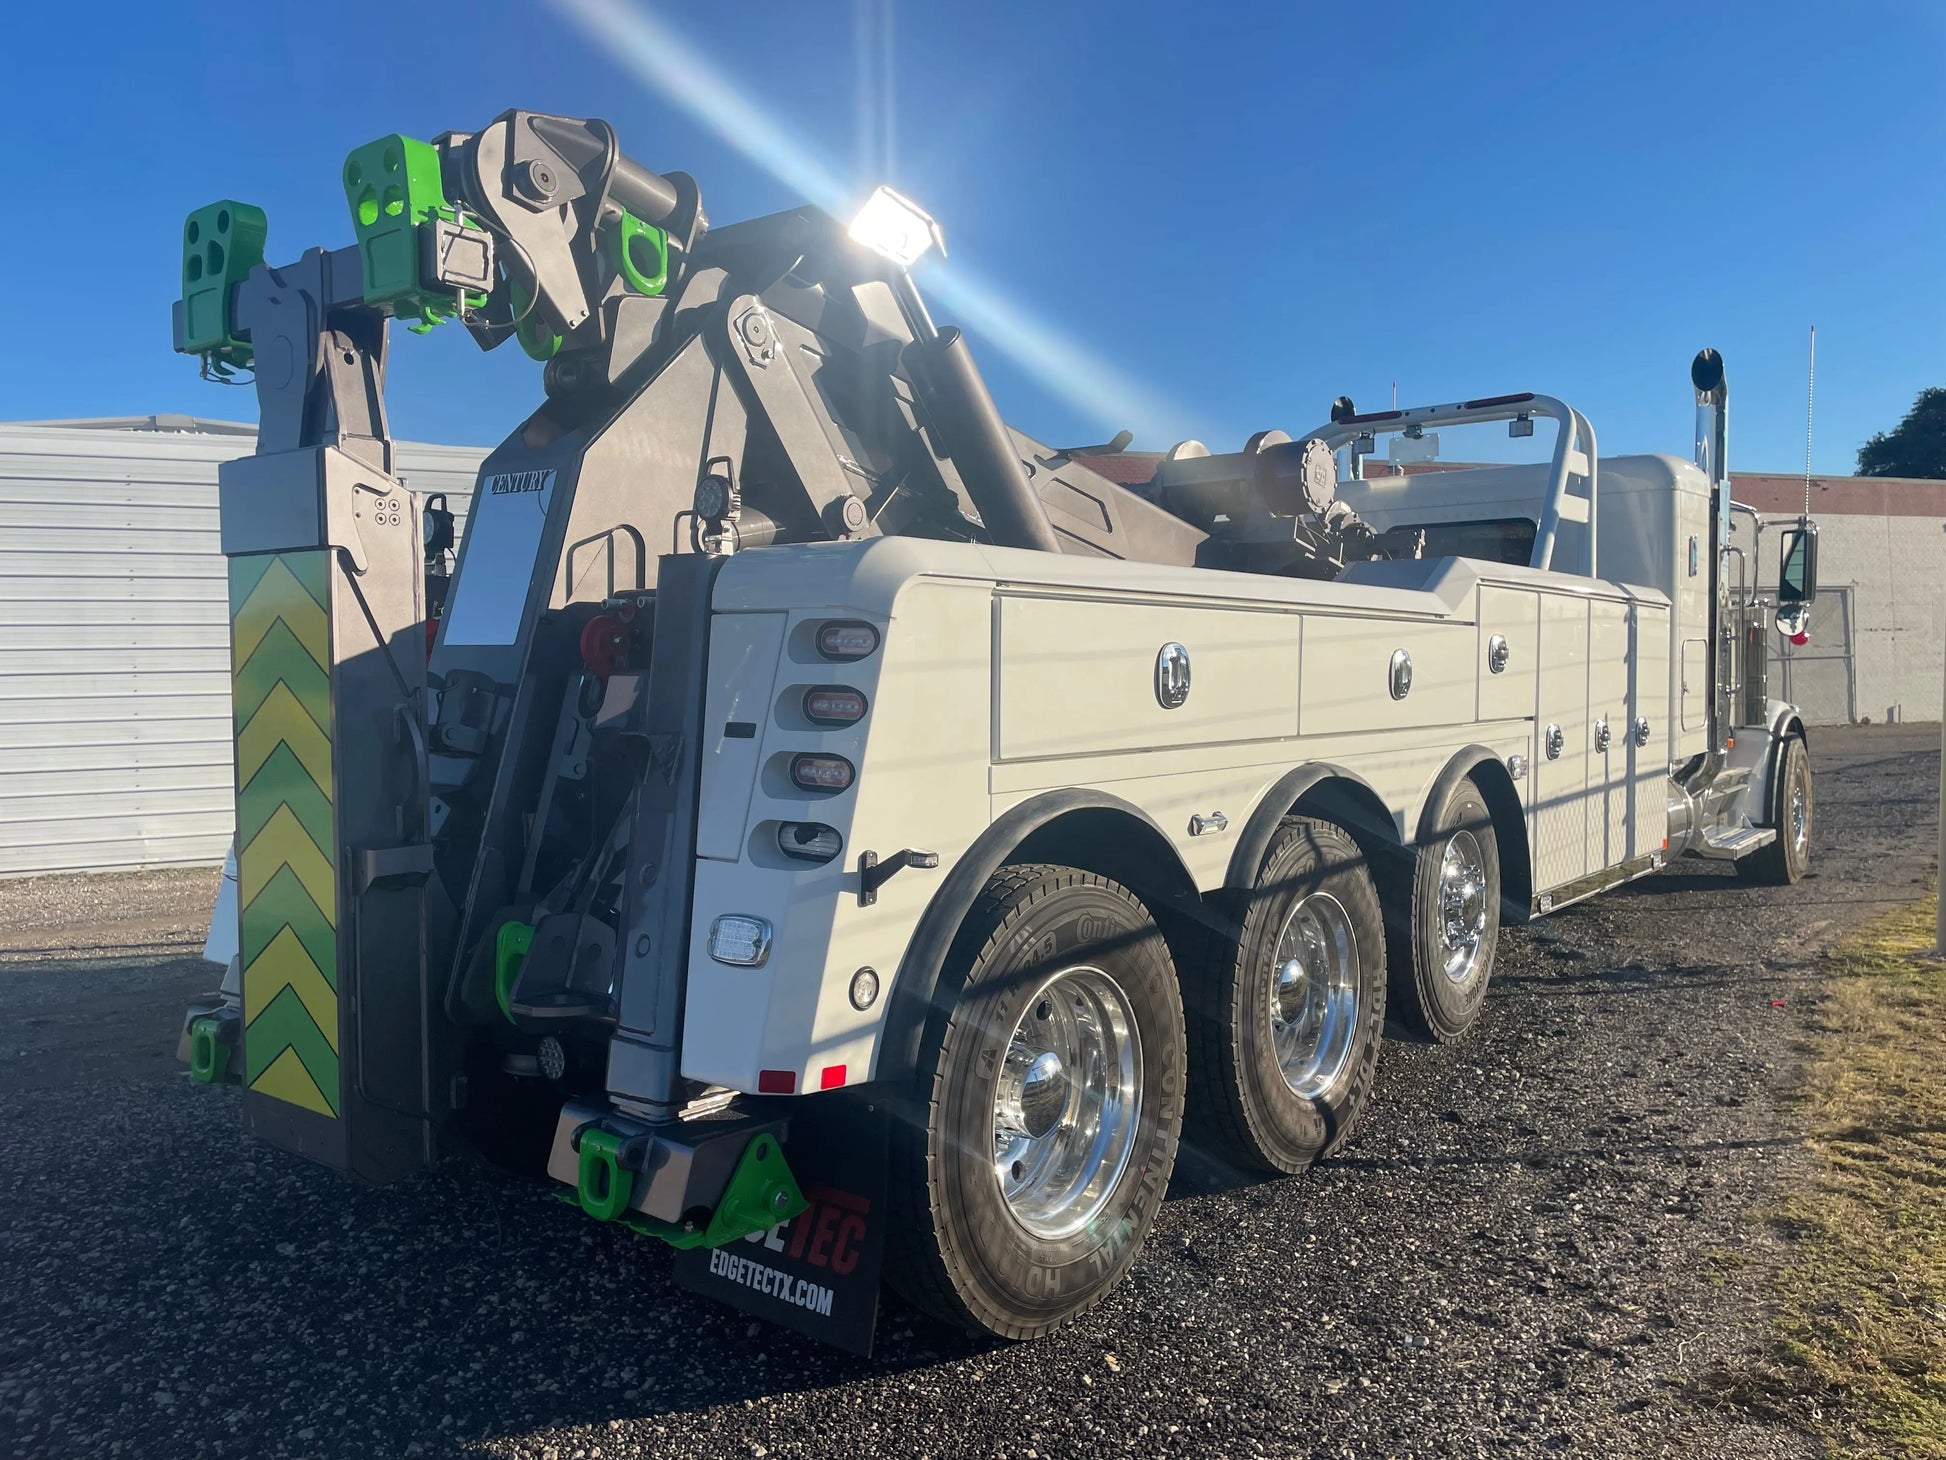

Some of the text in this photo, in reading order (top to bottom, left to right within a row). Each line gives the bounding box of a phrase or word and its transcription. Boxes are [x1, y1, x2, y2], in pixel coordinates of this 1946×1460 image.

[490, 469, 554, 494] CENTURY
[1088, 1043, 1175, 1281] CONTINENTAL
[709, 1248, 834, 1317] EDGETECTX.COM
